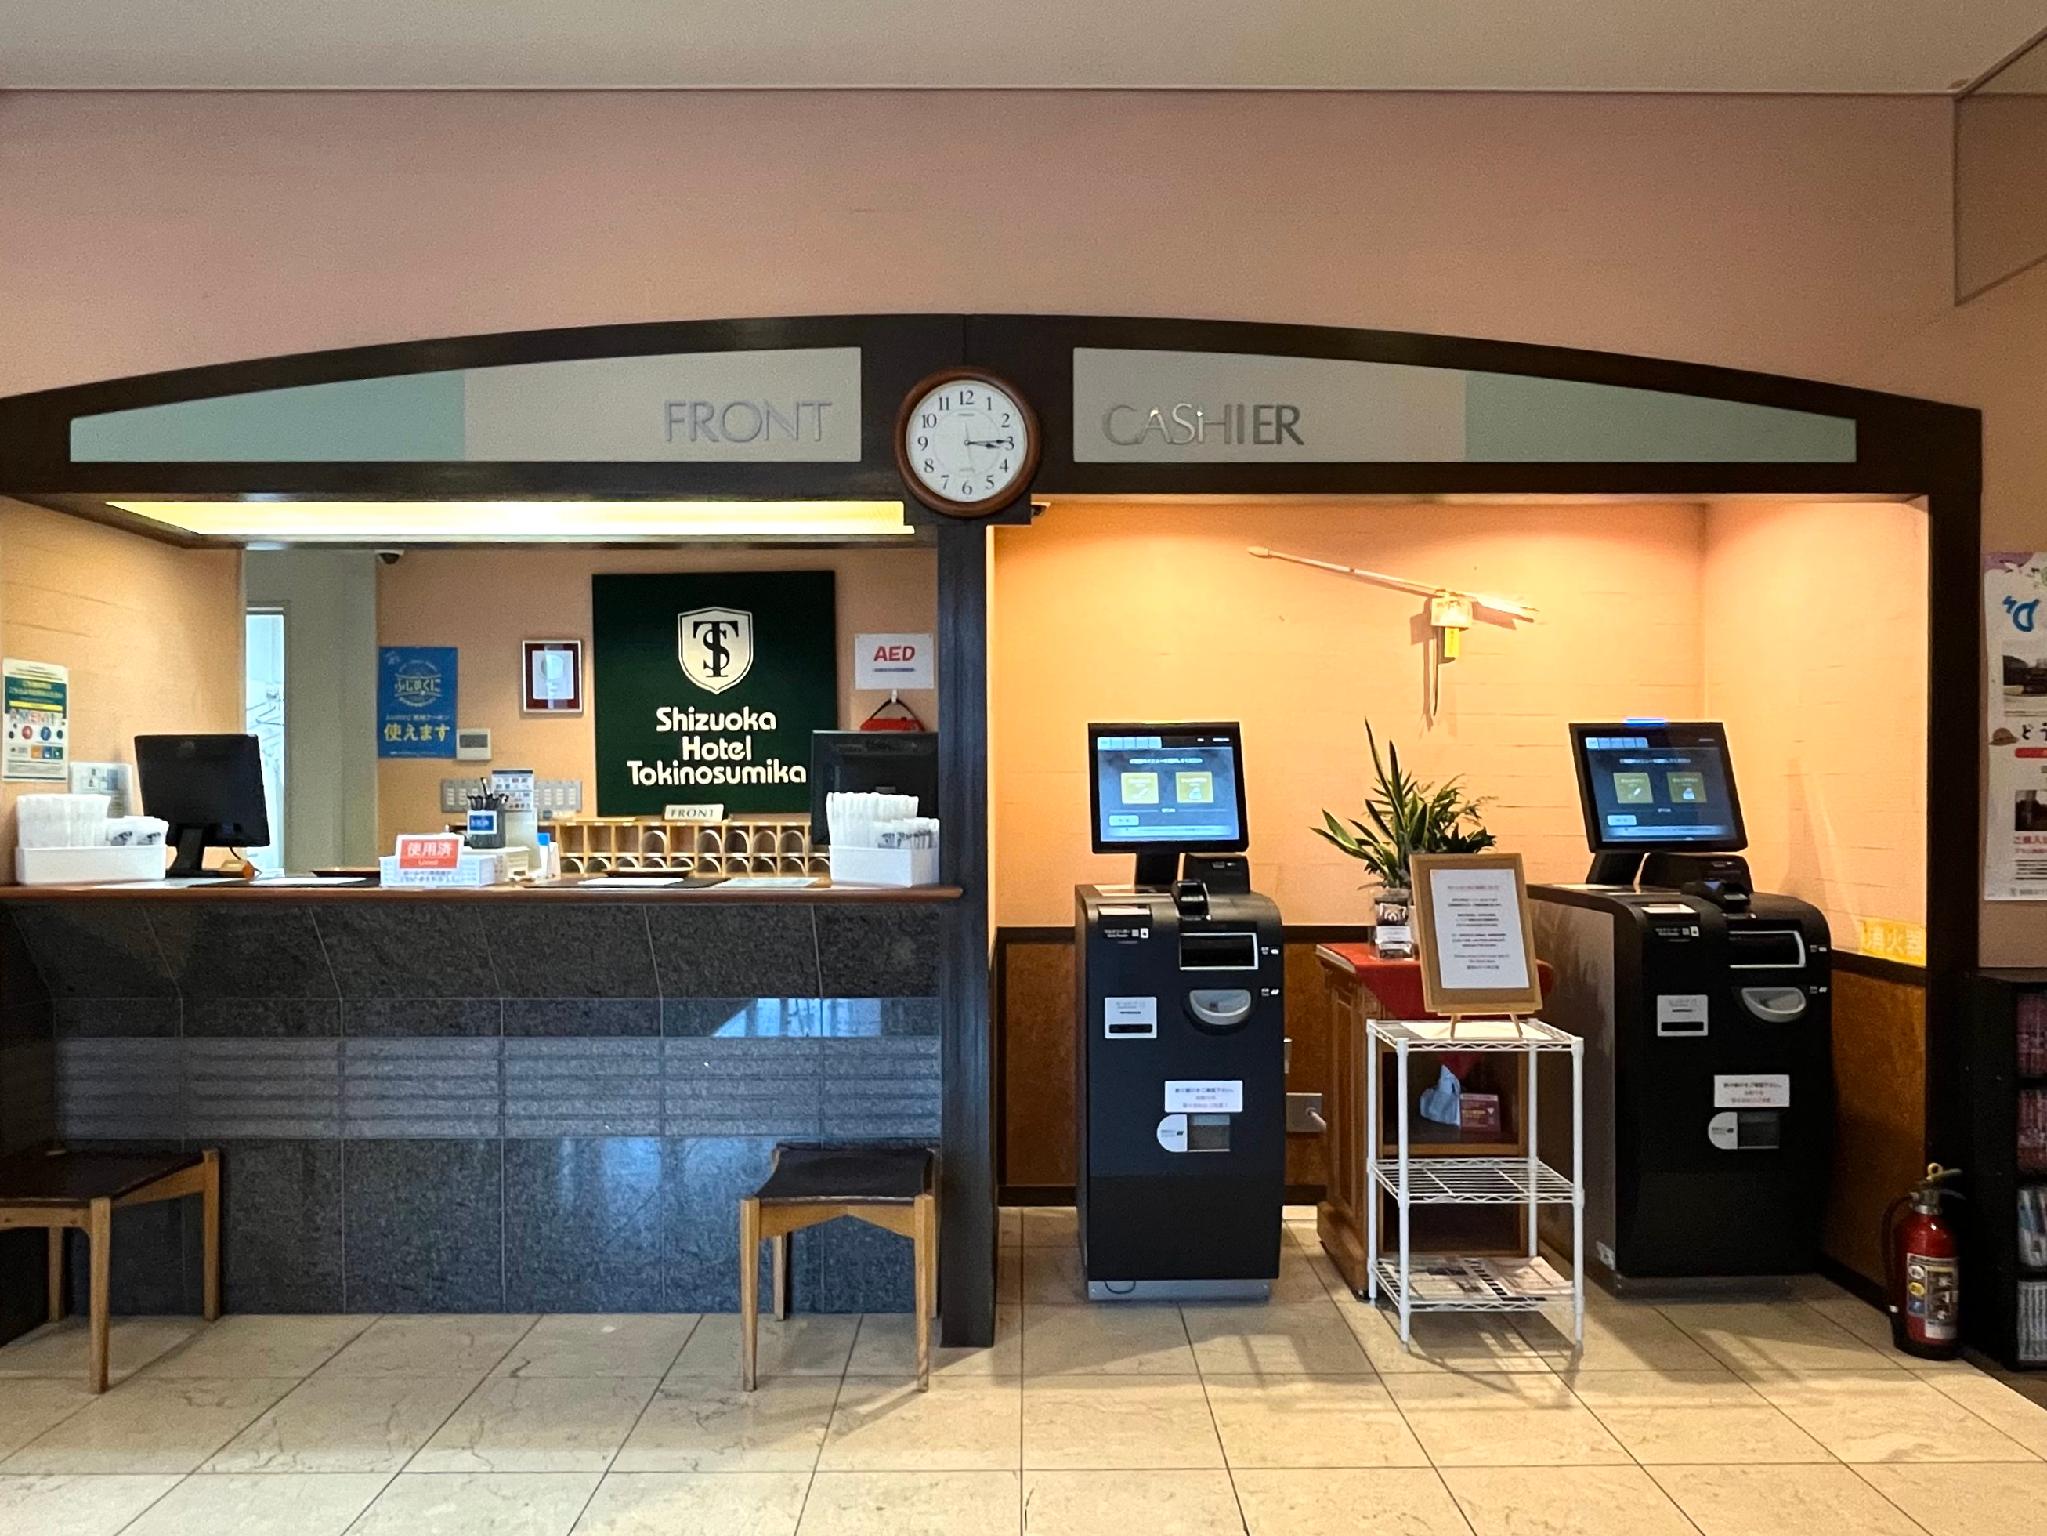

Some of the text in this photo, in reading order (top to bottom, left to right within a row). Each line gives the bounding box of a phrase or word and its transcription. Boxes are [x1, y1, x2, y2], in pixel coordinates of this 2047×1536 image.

[938, 396, 950, 411] 11
[959, 390, 975, 406] 12
[986, 396, 993, 411] 1
[664, 400, 832, 442] FRONT
[922, 412, 938, 429] 10
[1001, 412, 1011, 428] 2
[1102, 403, 1304, 445] CASHIER
[917, 436, 929, 451] 9
[1004, 436, 1015, 451] 3
[923, 459, 935, 473] 8
[999, 458, 1009, 473] 4
[941, 475, 950, 490] 7
[961, 480, 973, 495] 6
[985, 475, 995, 489] 5
[874, 646, 916, 662] AED
[655, 705, 777, 732] Shizuoka
[384, 722, 451, 742] 使えます
[681, 734, 752, 761] Hotel
[626, 758, 807, 786] Tokinosumika
[670, 809, 714, 818] FRONT
[407, 841, 451, 858] 使用済
